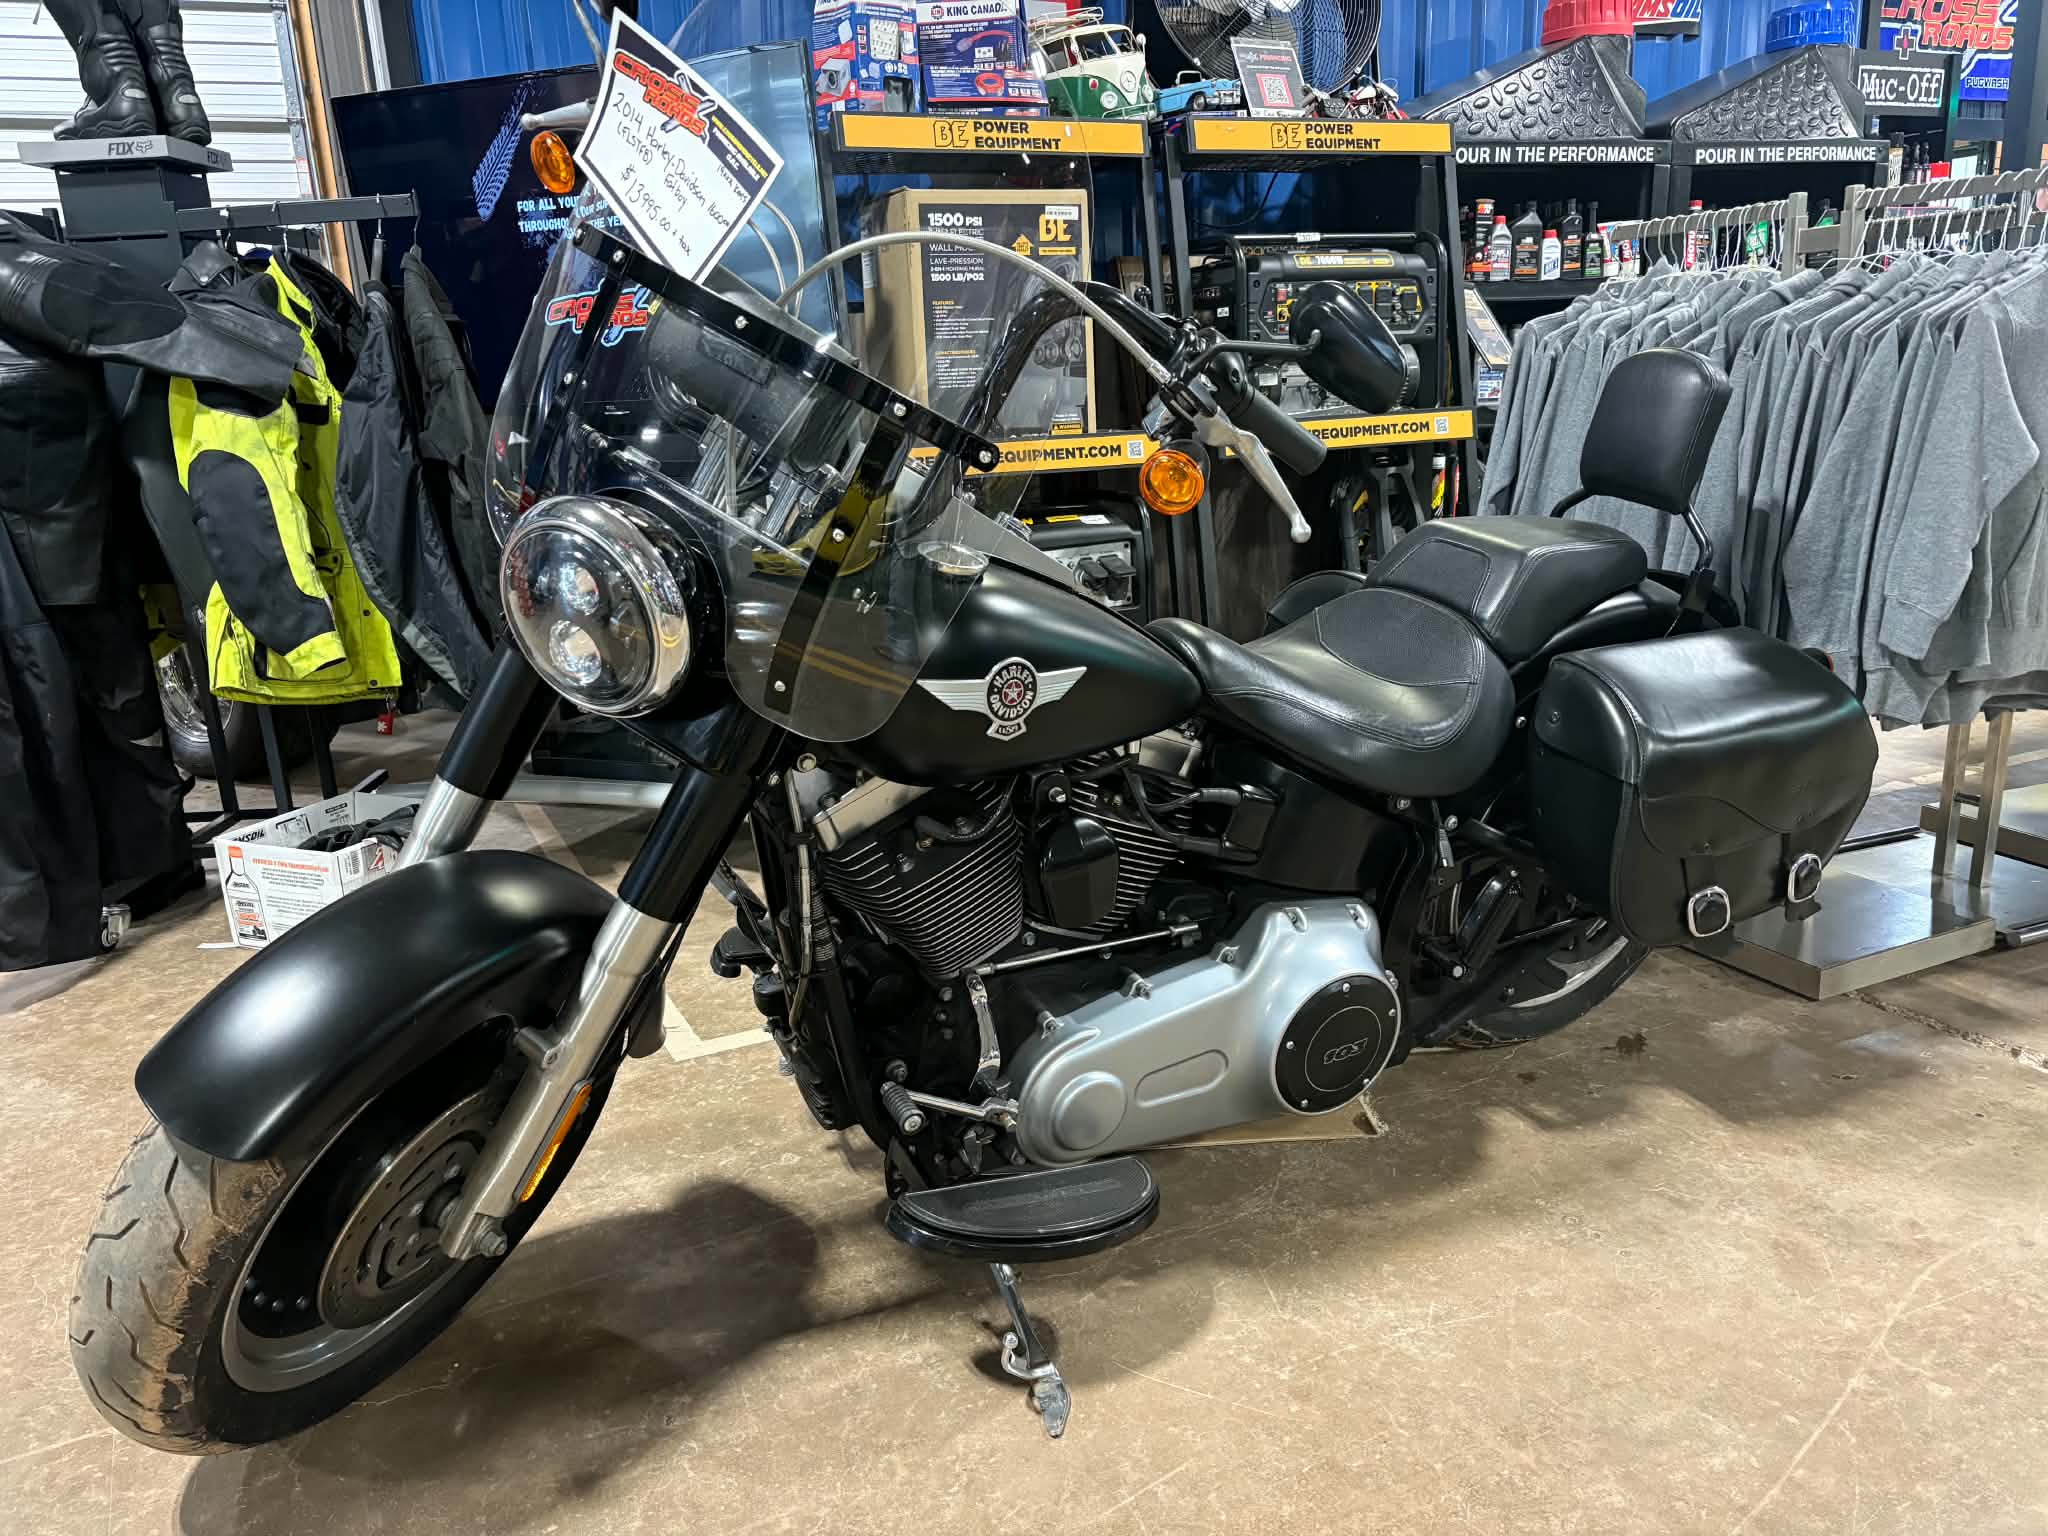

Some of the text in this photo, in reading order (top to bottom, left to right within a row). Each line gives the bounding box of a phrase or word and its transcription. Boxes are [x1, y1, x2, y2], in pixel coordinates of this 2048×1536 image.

[946, 2, 1008, 17] KING CANAD
[1922, 22, 2014, 50] ROADS
[614, 51, 701, 109] CROSS
[1862, 72, 1941, 102] Muc-Off
[613, 92, 644, 133] 2014
[643, 88, 706, 137] ROADS
[933, 120, 1030, 148] BE POWER
[975, 136, 1061, 150] EQUIPMENT
[1271, 123, 1353, 149] BE POWER
[108, 141, 135, 156] FOX
[1306, 137, 1381, 150] EQUIPMENT
[1455, 146, 1654, 164] OUR IN THE PERFORMANCE
[1695, 146, 1876, 164] POUR IN THE PERFORMANCE
[517, 200, 535, 213] FOR
[539, 197, 556, 212] ALL
[927, 212, 983, 227] 1500 PSI
[929, 243, 954, 252] WALL
[929, 257, 984, 265] LAVE-PRESSION
[998, 445, 1122, 464] EQUIPMENT.COM
[993, 665, 1033, 687] HARLEY
[989, 690, 1035, 719] DAVIDSON
